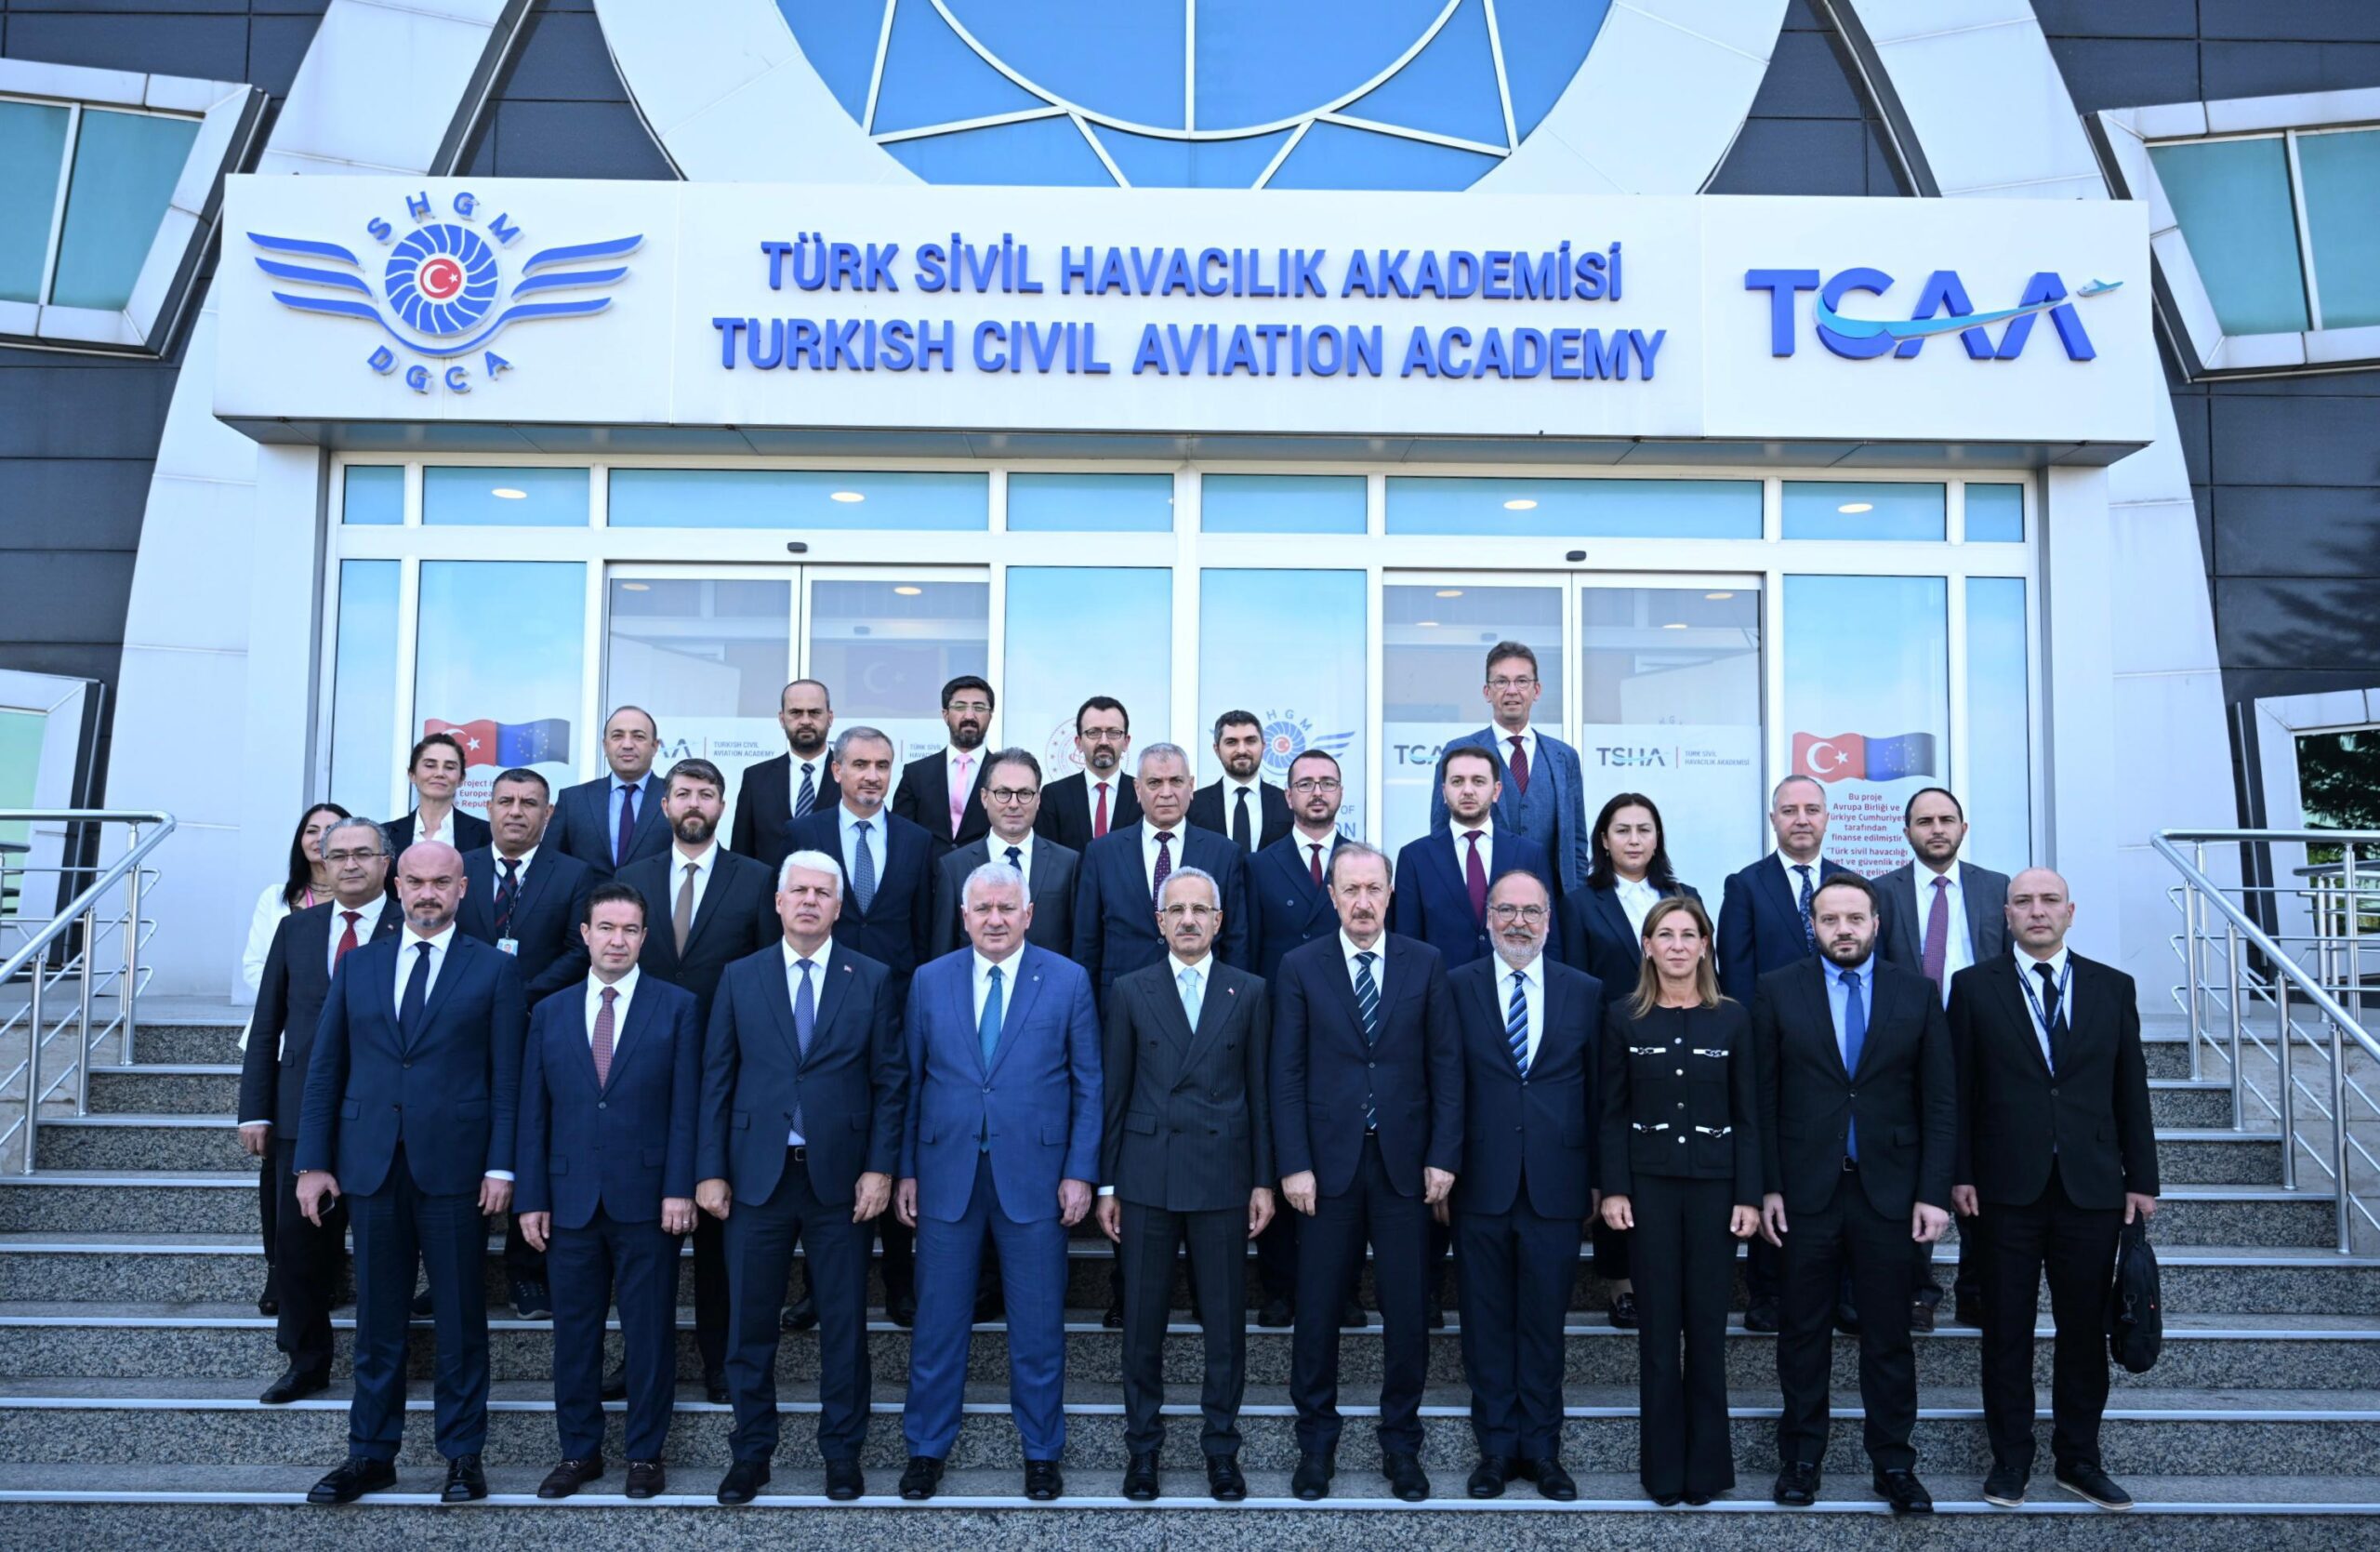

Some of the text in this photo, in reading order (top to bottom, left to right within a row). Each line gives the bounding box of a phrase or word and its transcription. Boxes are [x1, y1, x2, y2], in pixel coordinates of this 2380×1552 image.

[366, 190, 525, 248] SHGM
[760, 231, 1623, 302] TÜRK SİVİL HAVACILIK AKADEMİSİ
[1744, 266, 2098, 363] TCAA
[712, 316, 1668, 383] TURKISH CIVIL AVIATION ACADEMY
[366, 344, 515, 395] DGCA
[1265, 709, 1313, 732] HGM
[1394, 744, 1442, 765] TCA
[1595, 747, 1665, 766] TSHA
[459, 789, 493, 798] Europea
[1848, 792, 1883, 803] Bu proje
[1341, 805, 1355, 815] OF
[1833, 803, 1862, 812] Avrupa
[1864, 803, 1888, 813] Birliği
[1830, 813, 1906, 823] ürkiye Cumhuriyet
[1864, 834, 1902, 843] edilmiştir
[1850, 847, 1868, 856] sivil
[1858, 857, 1893, 867] güvenlik
